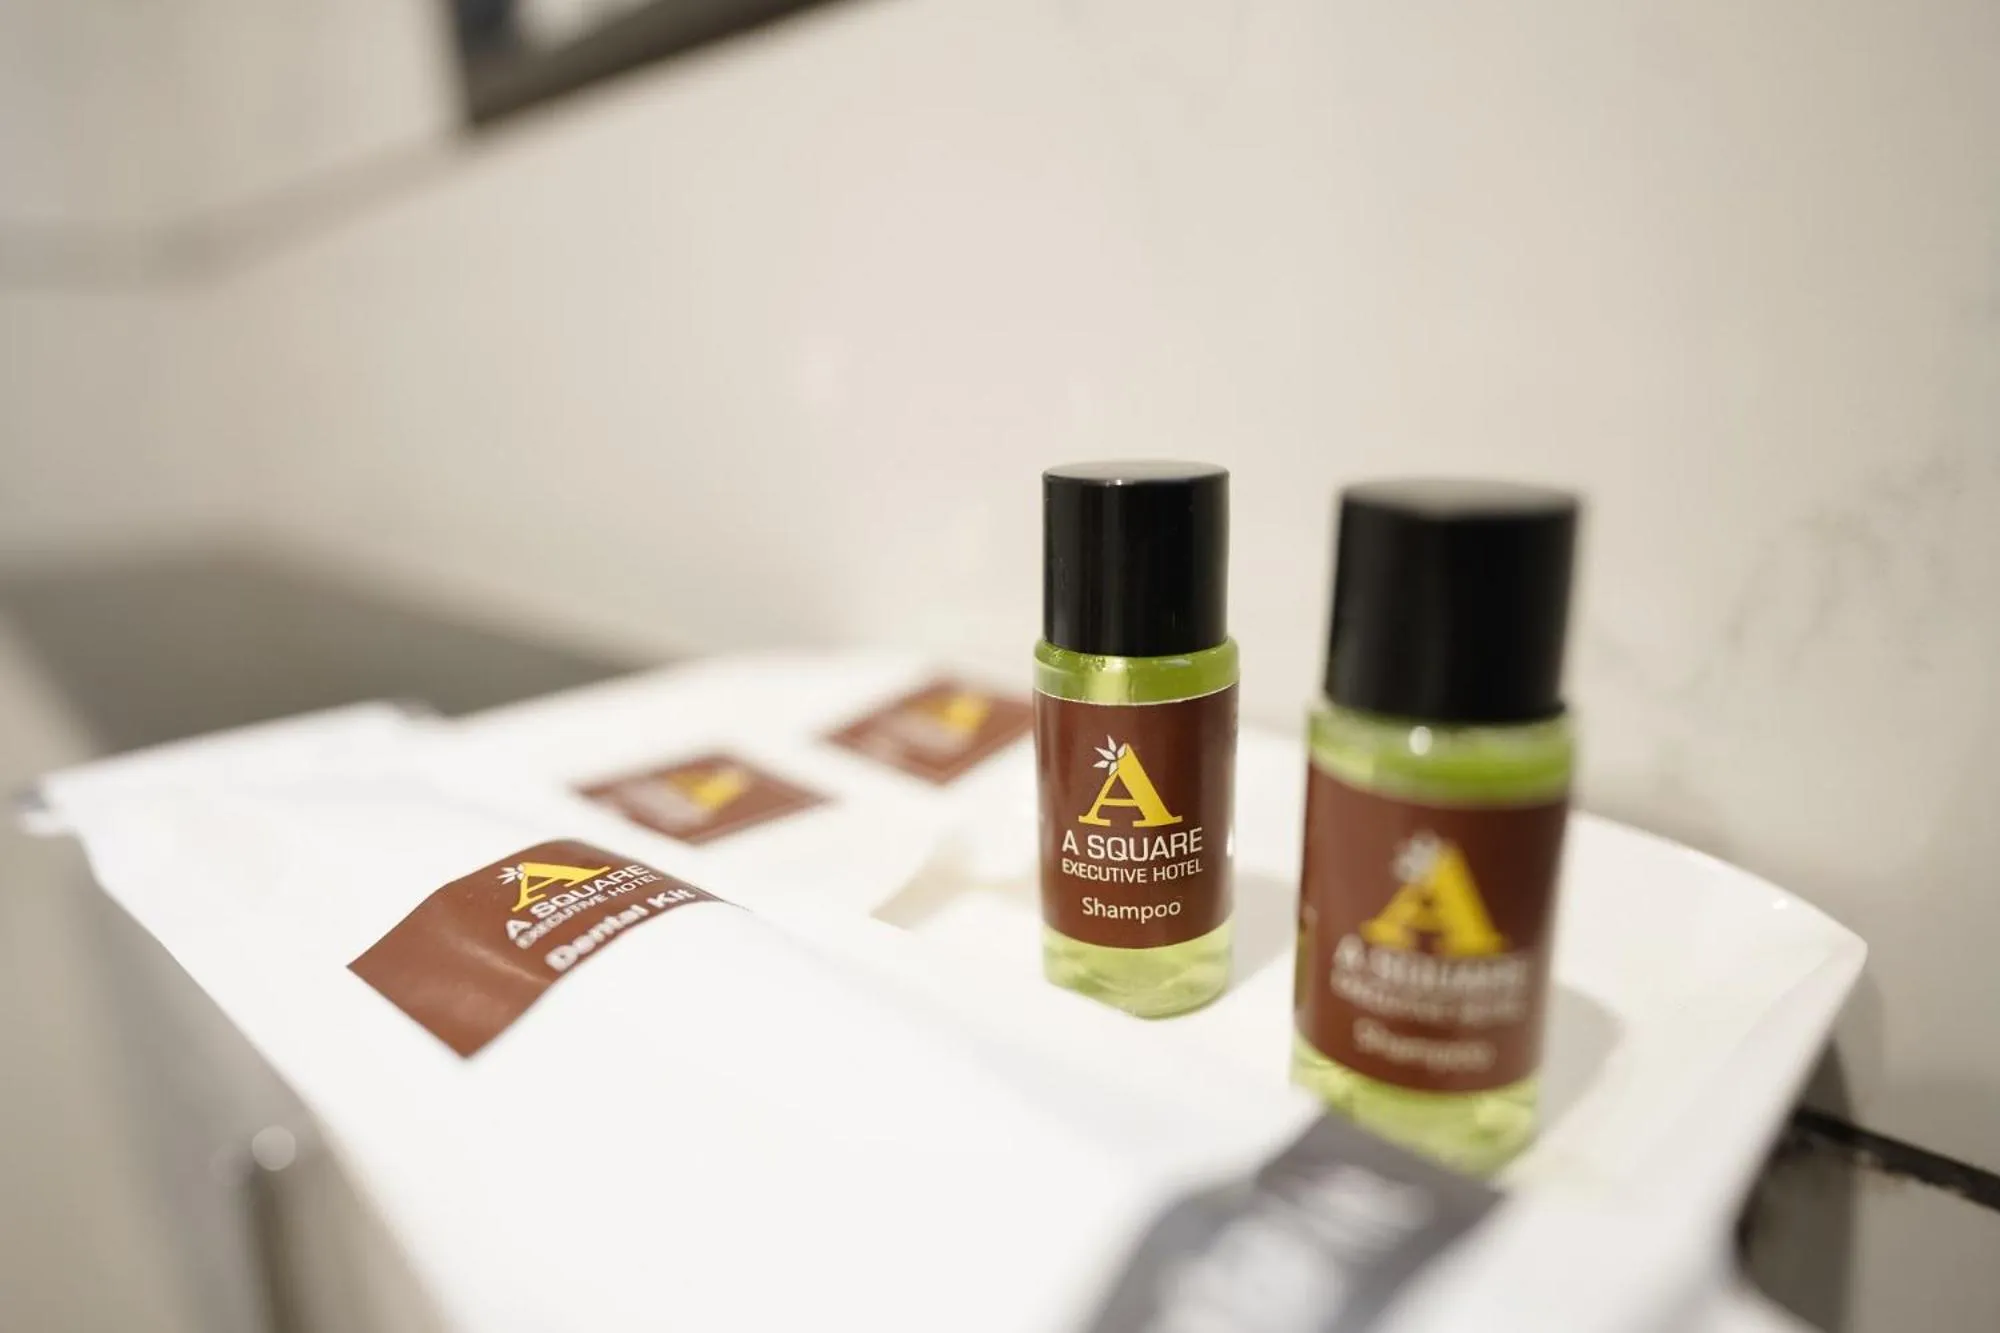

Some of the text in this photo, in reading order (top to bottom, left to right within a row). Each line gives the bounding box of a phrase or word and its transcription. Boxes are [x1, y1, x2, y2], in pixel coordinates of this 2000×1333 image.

[1079, 743, 1183, 827] A
[1062, 827, 1203, 861] A SQUARE
[608, 874, 665, 897] HOTEL
[1062, 858, 1203, 883] EXECUTIVE HOTEL
[512, 862, 611, 912] A
[645, 888, 697, 909] Kit
[506, 864, 650, 941] A SQUARE
[1082, 897, 1181, 924] Shampoo
